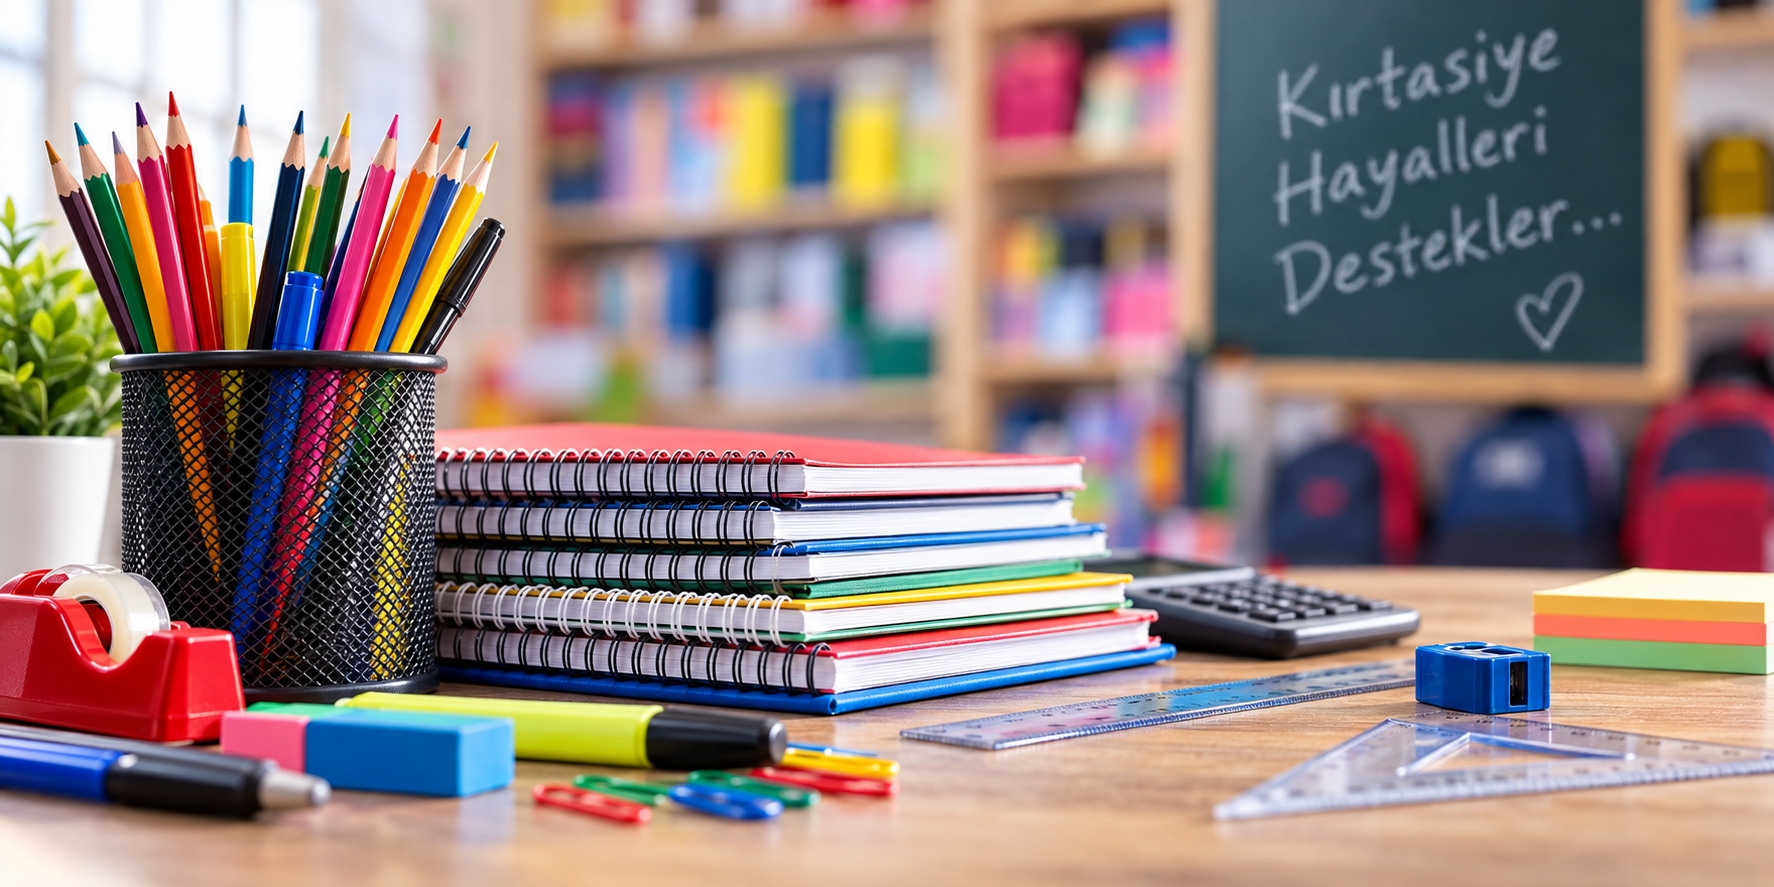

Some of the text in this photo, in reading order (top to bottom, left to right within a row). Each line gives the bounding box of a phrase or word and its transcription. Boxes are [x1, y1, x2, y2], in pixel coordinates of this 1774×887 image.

[1277, 28, 1560, 140] Kırtasiye
[1275, 106, 1548, 226] Hayalleri
[1275, 193, 1622, 314] Destekler...
